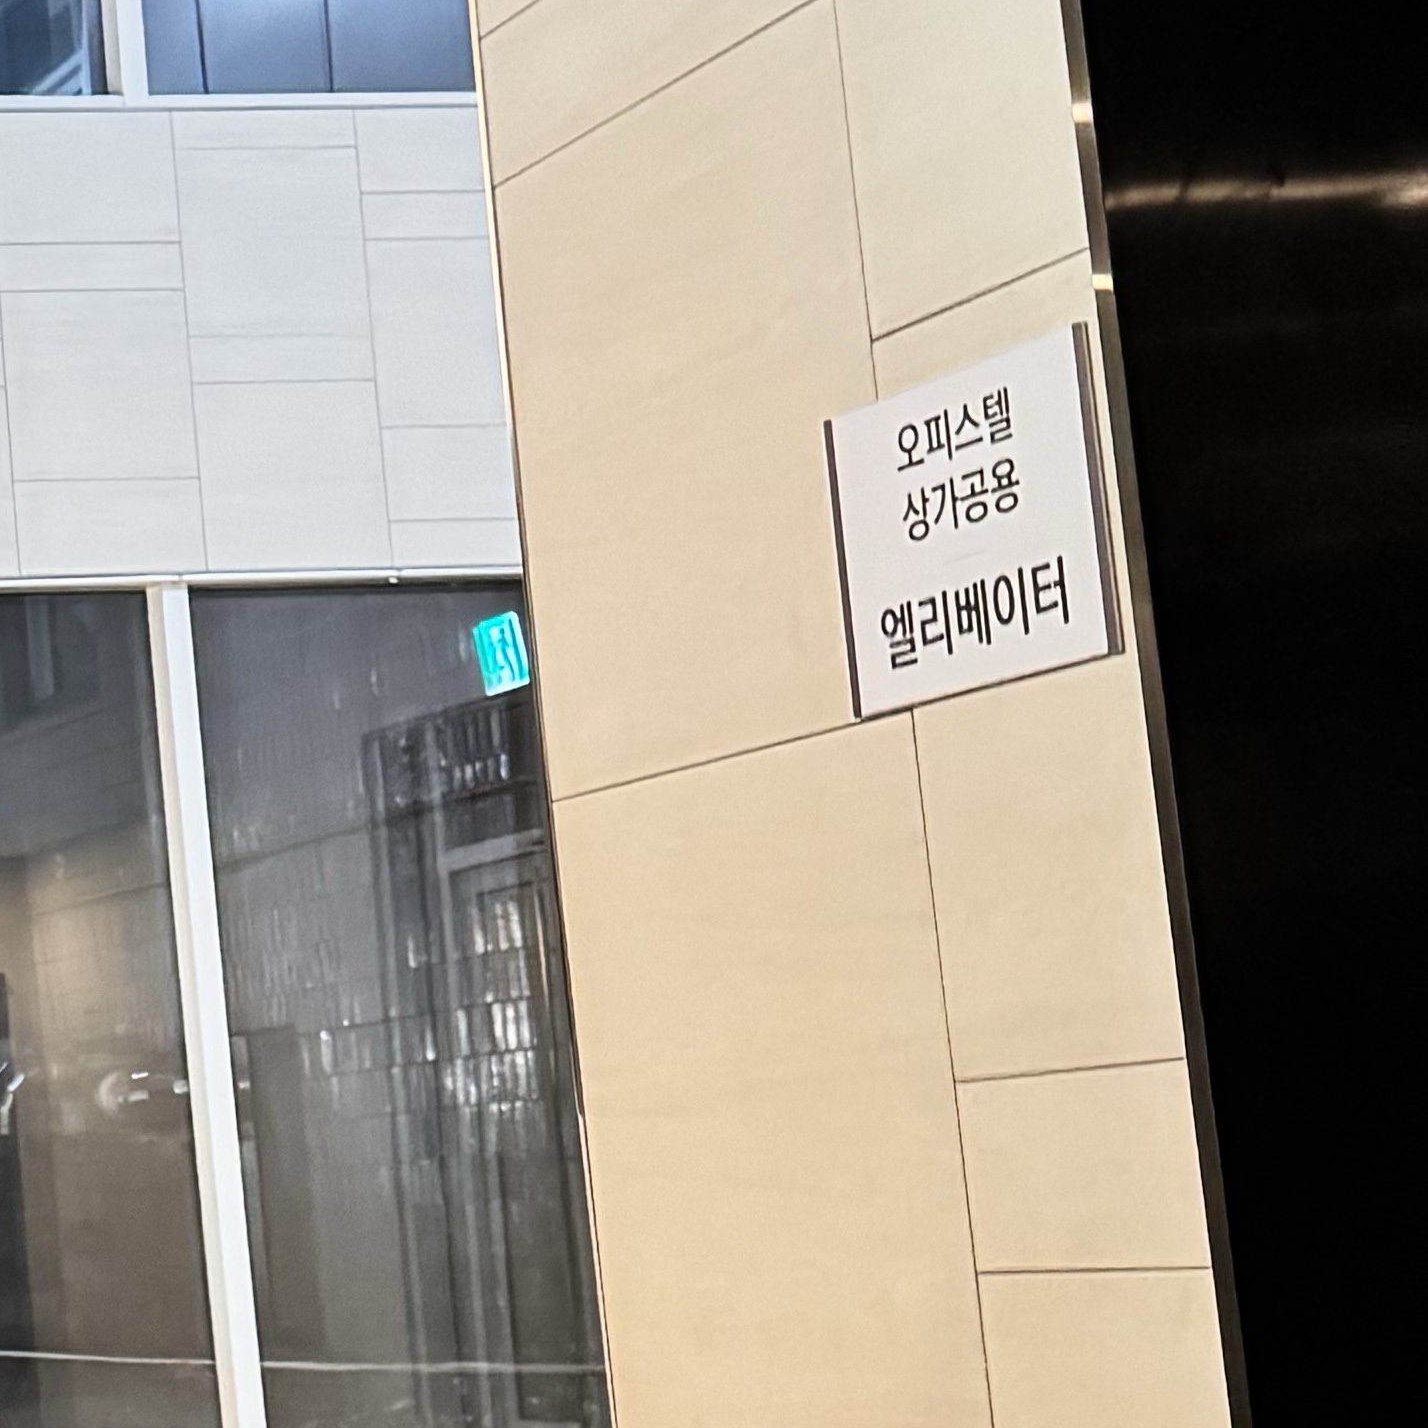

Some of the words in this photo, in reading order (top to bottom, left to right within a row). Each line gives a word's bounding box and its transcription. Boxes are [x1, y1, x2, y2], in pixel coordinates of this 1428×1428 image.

[896, 386, 1014, 472] 오피스텔
[902, 458, 1020, 542] 상가공용
[881, 555, 1070, 670] 엘리베이터
